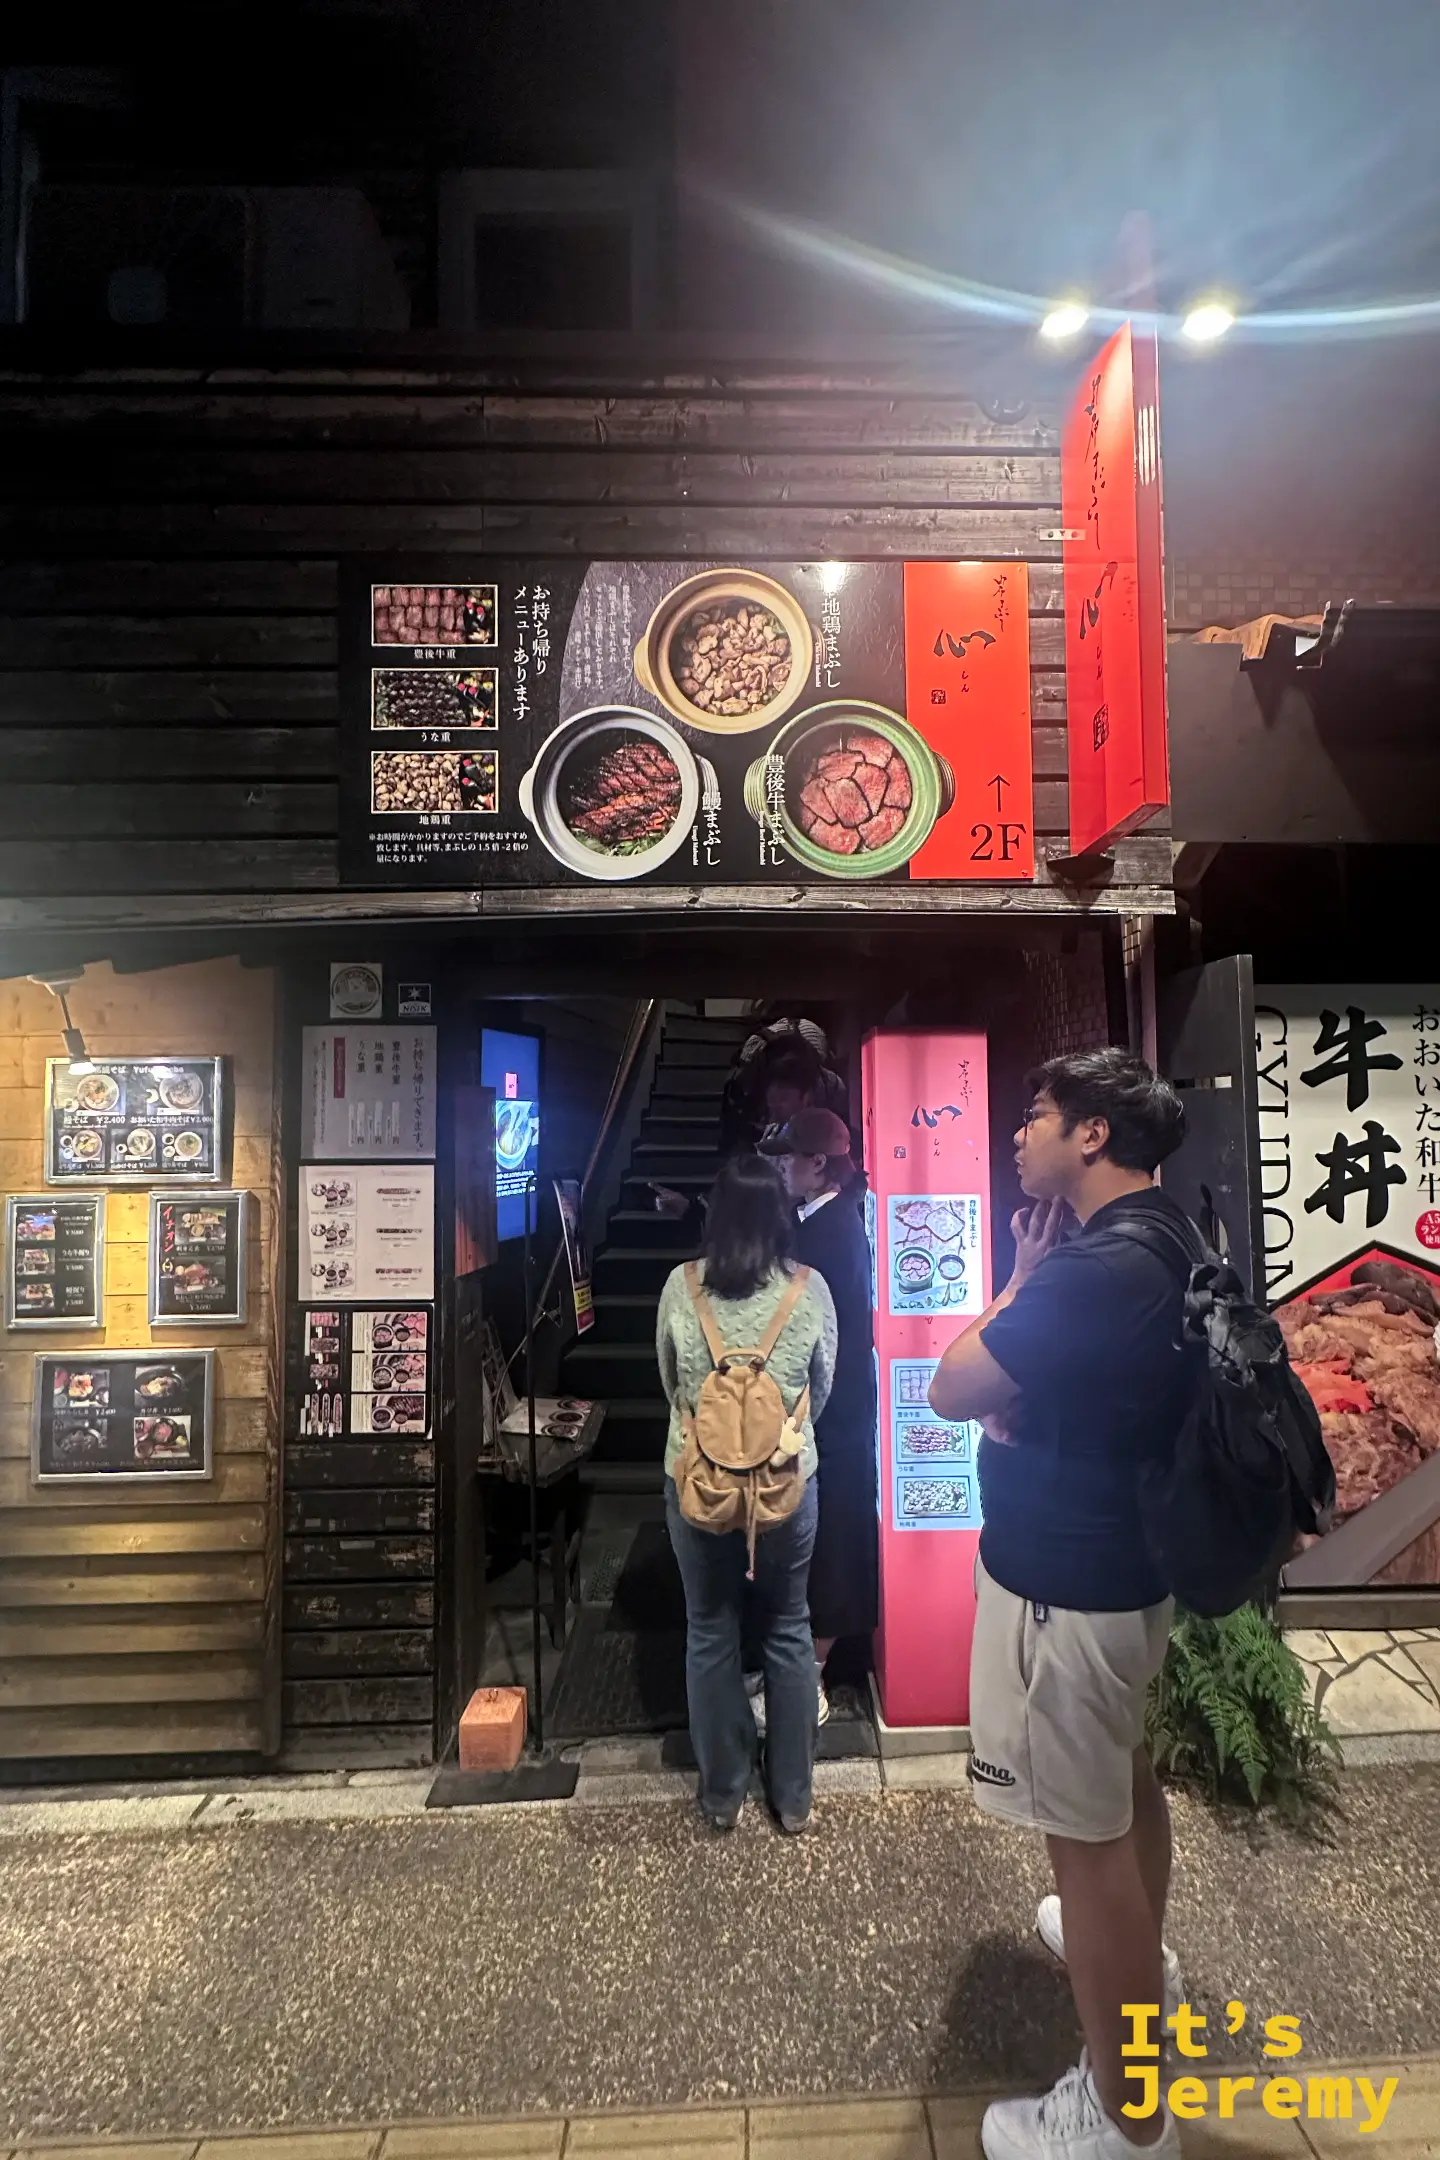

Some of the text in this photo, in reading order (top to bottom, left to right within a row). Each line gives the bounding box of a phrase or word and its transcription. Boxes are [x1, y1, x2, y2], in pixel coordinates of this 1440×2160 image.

[512, 585, 530, 720] メニューあります
[532, 585, 551, 675] お持ち帰り
[933, 629, 996, 658] 心
[421, 731, 451, 742] うな重
[702, 791, 722, 866] 鰻まぶし
[766, 754, 786, 866] 豊後牛まぶし
[970, 823, 1026, 861] 2F
[911, 1105, 962, 1128] 心
[1300, 1005, 1407, 1229] 牛丼
[163, 1205, 175, 1253] イチオシ
